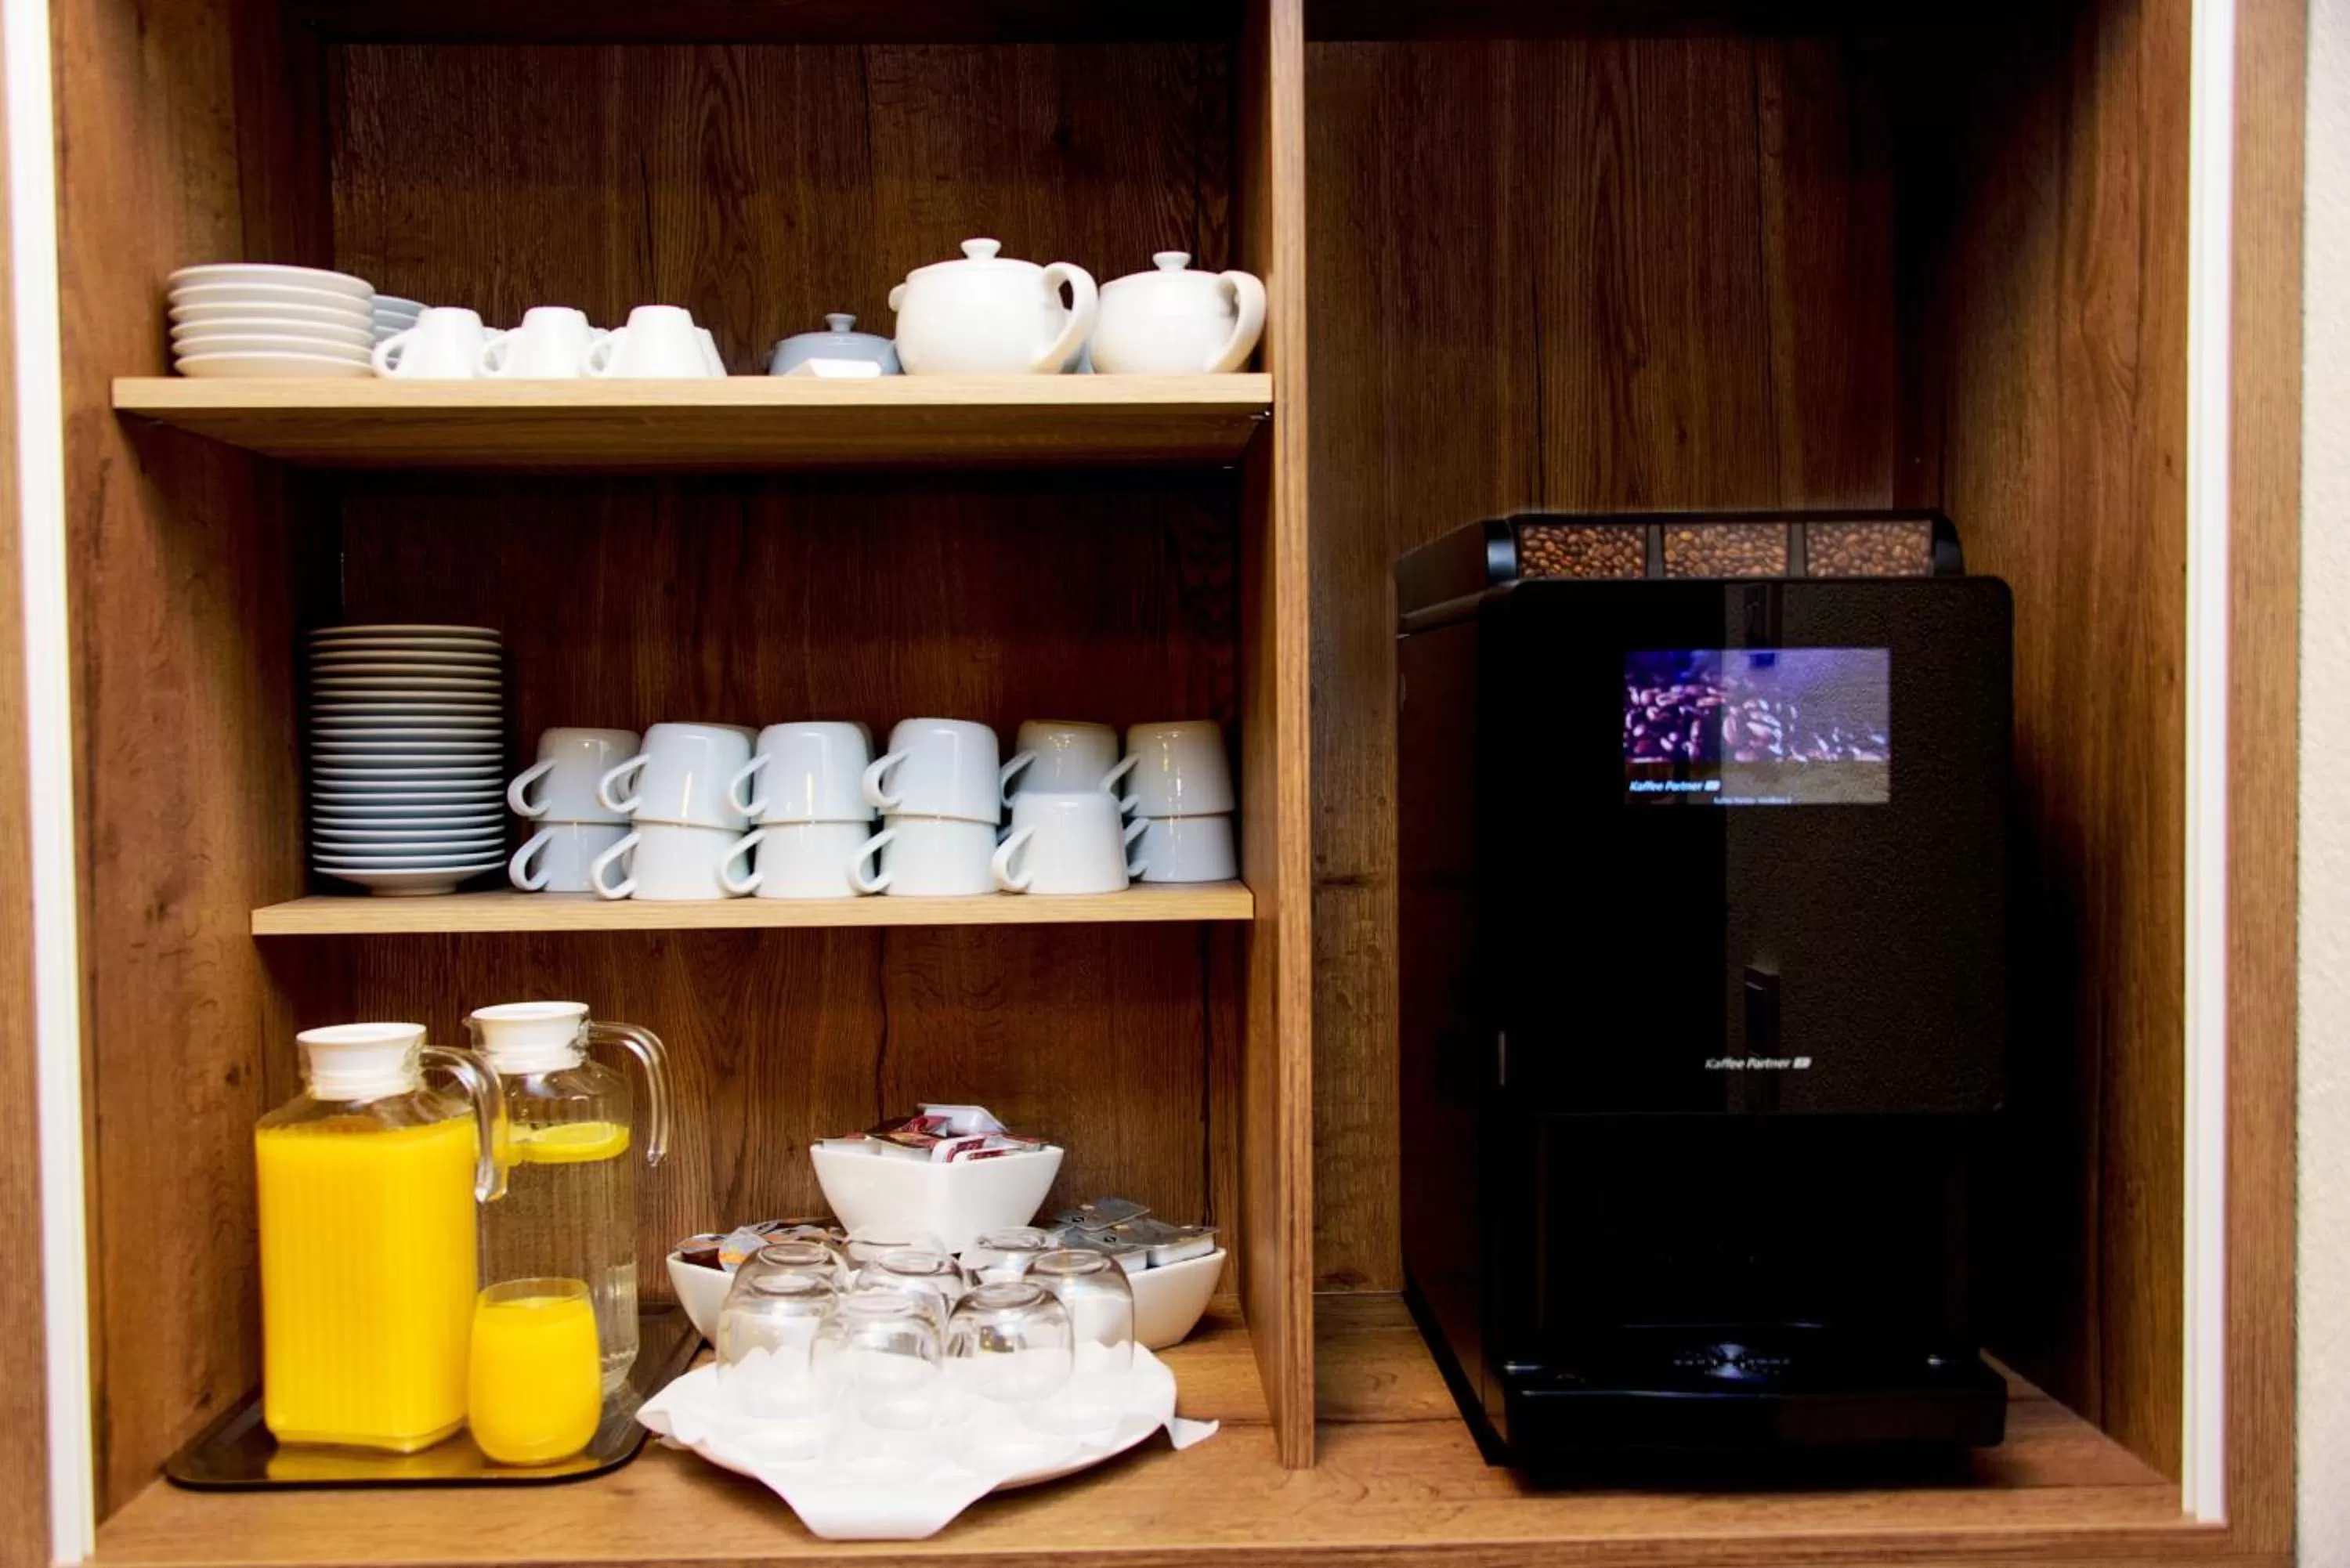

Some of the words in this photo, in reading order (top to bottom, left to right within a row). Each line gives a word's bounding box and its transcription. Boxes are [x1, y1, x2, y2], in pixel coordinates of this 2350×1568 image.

[1629, 779, 1664, 792] Kaffee
[1665, 780, 1703, 792] Partner
[1705, 1057, 1745, 1070] Kaffee
[1746, 1057, 1791, 1070] Partner
